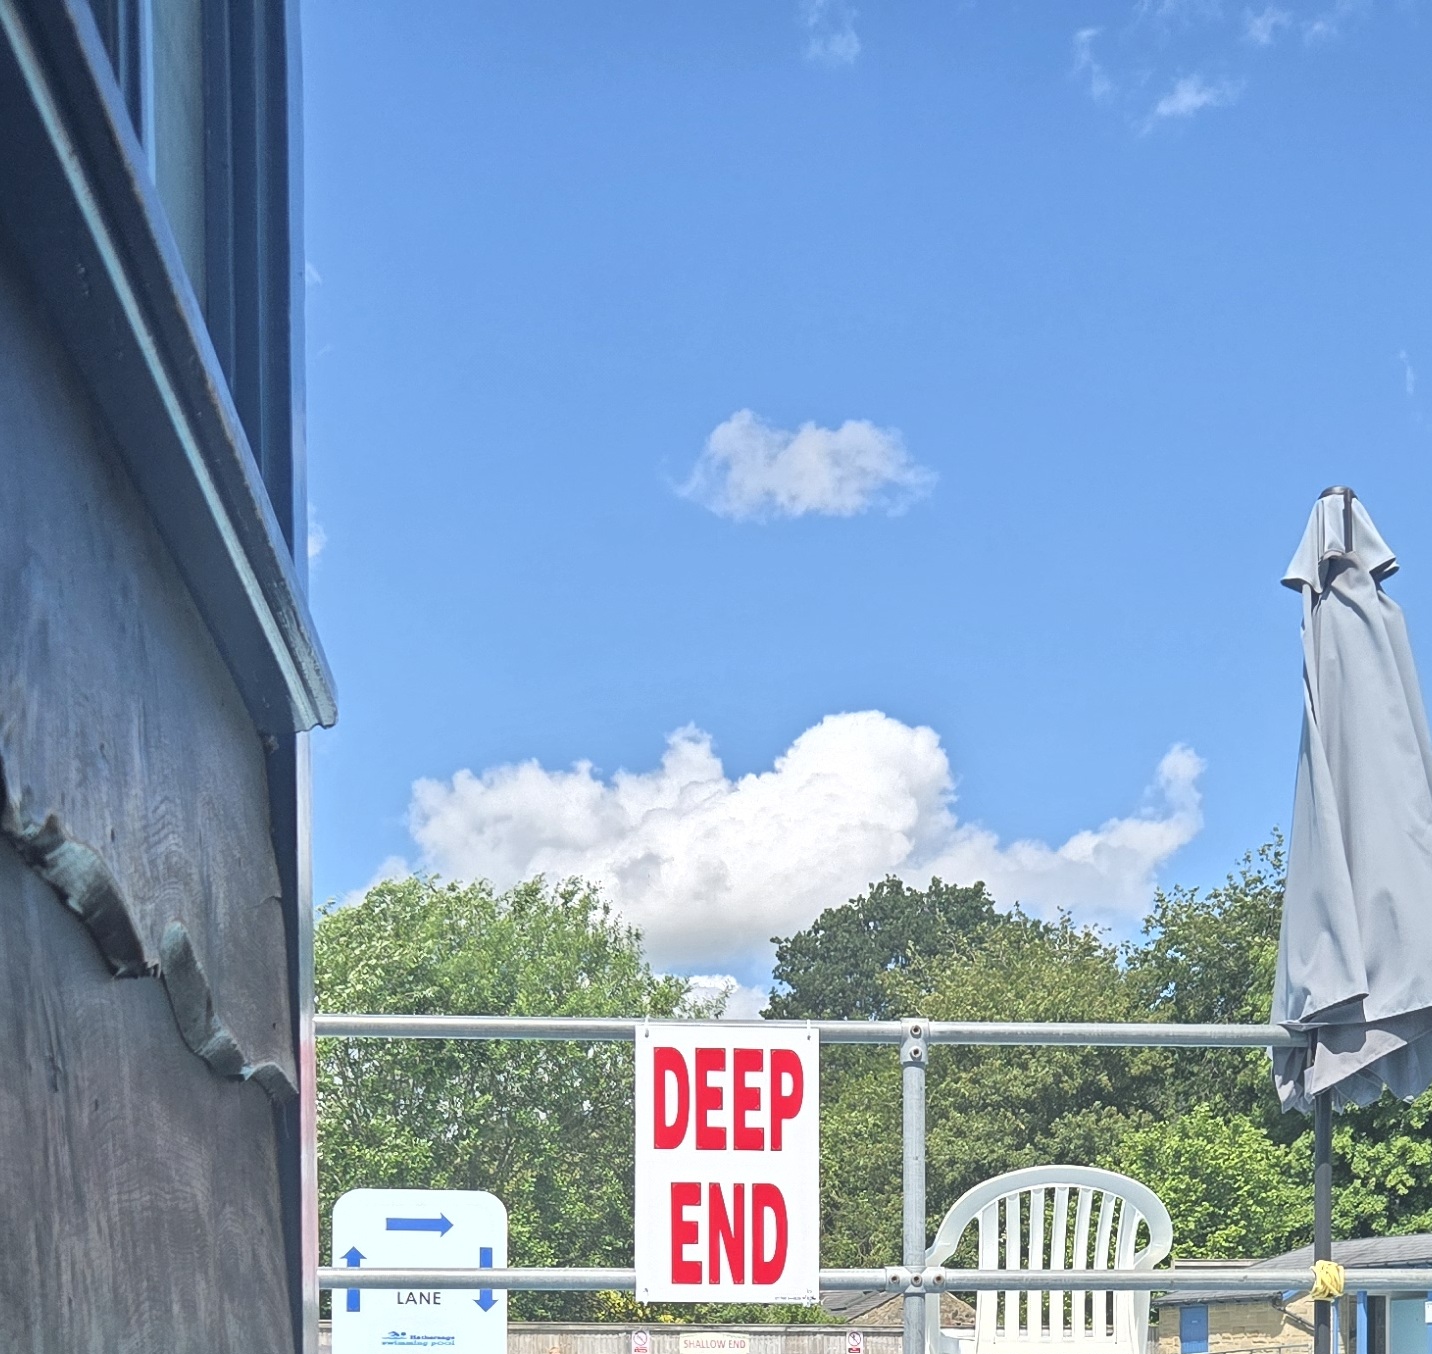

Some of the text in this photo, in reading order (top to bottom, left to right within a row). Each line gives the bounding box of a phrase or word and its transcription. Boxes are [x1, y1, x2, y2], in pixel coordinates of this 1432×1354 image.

[654, 1047, 804, 1151] DEEP
[671, 1182, 788, 1284] END
[397, 1291, 442, 1305] LANE
[684, 1339, 746, 1348] SHALLOW END
